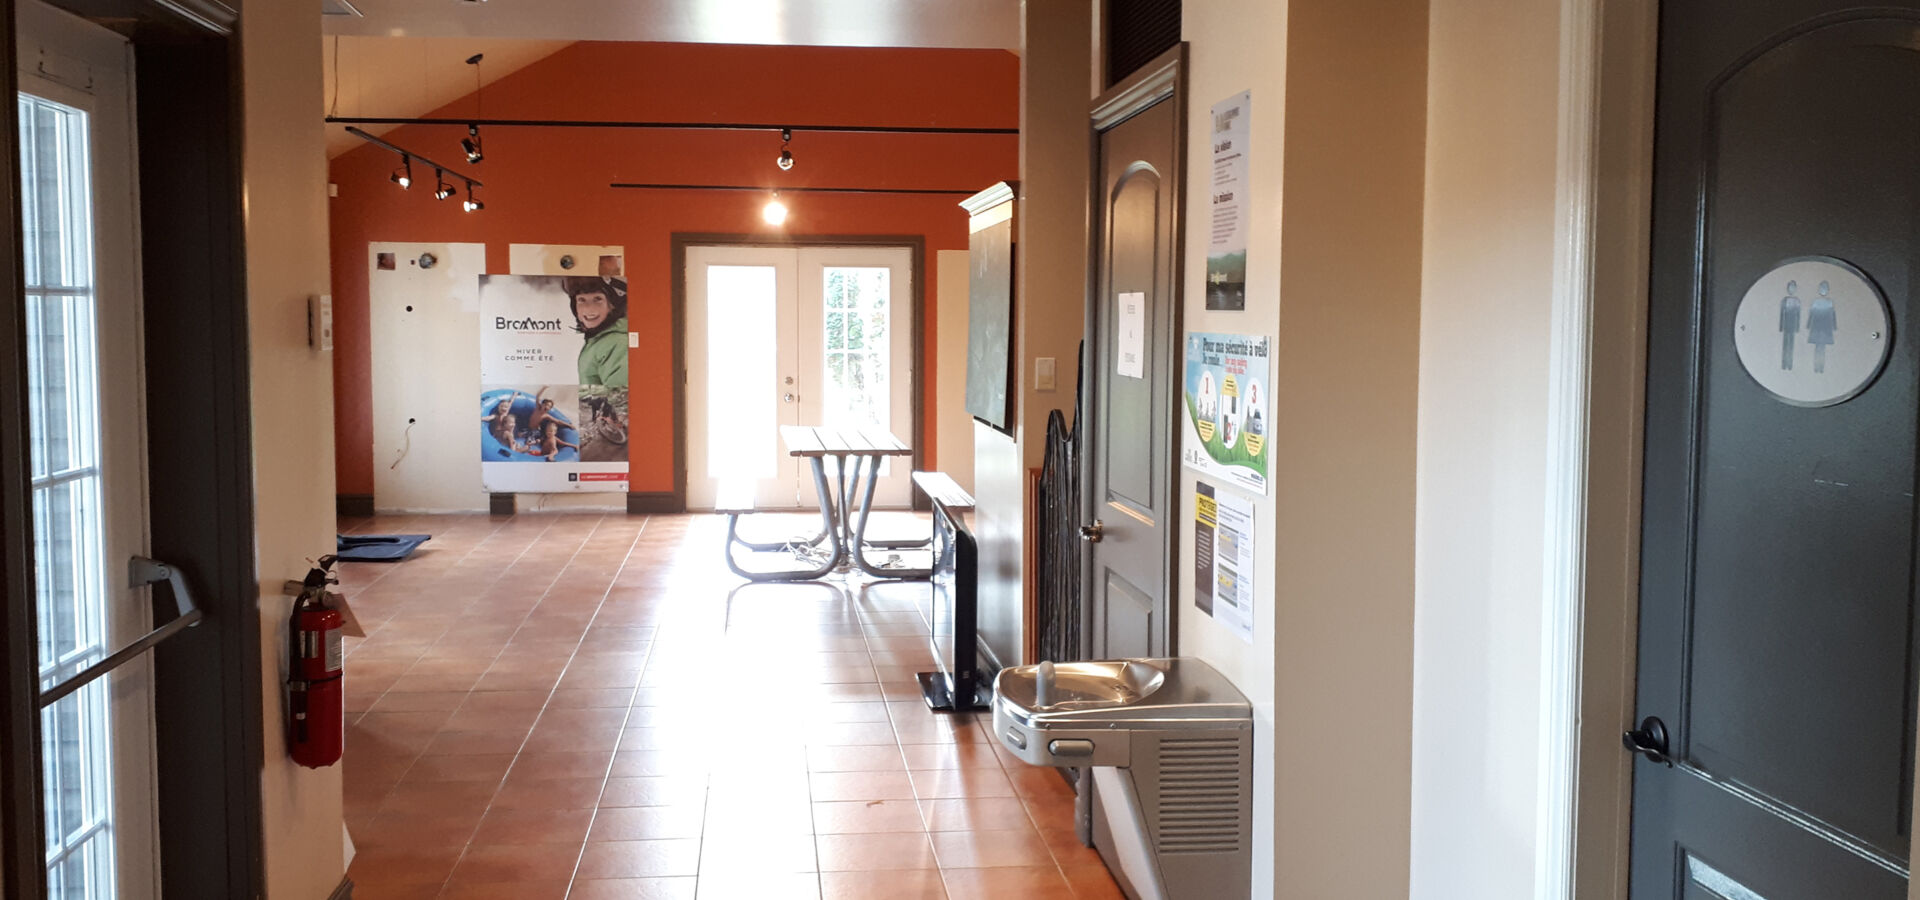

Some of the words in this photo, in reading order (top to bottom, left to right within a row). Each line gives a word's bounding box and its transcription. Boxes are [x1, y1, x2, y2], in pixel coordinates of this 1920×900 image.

[495, 316, 562, 331] Bromont
[1202, 337, 1215, 353] Pour
[1215, 342, 1225, 354] ma
[1225, 339, 1248, 356] sécurité
[1248, 340, 1254, 357] à
[1205, 376, 1209, 394] 1
[1251, 384, 1257, 404] 3
